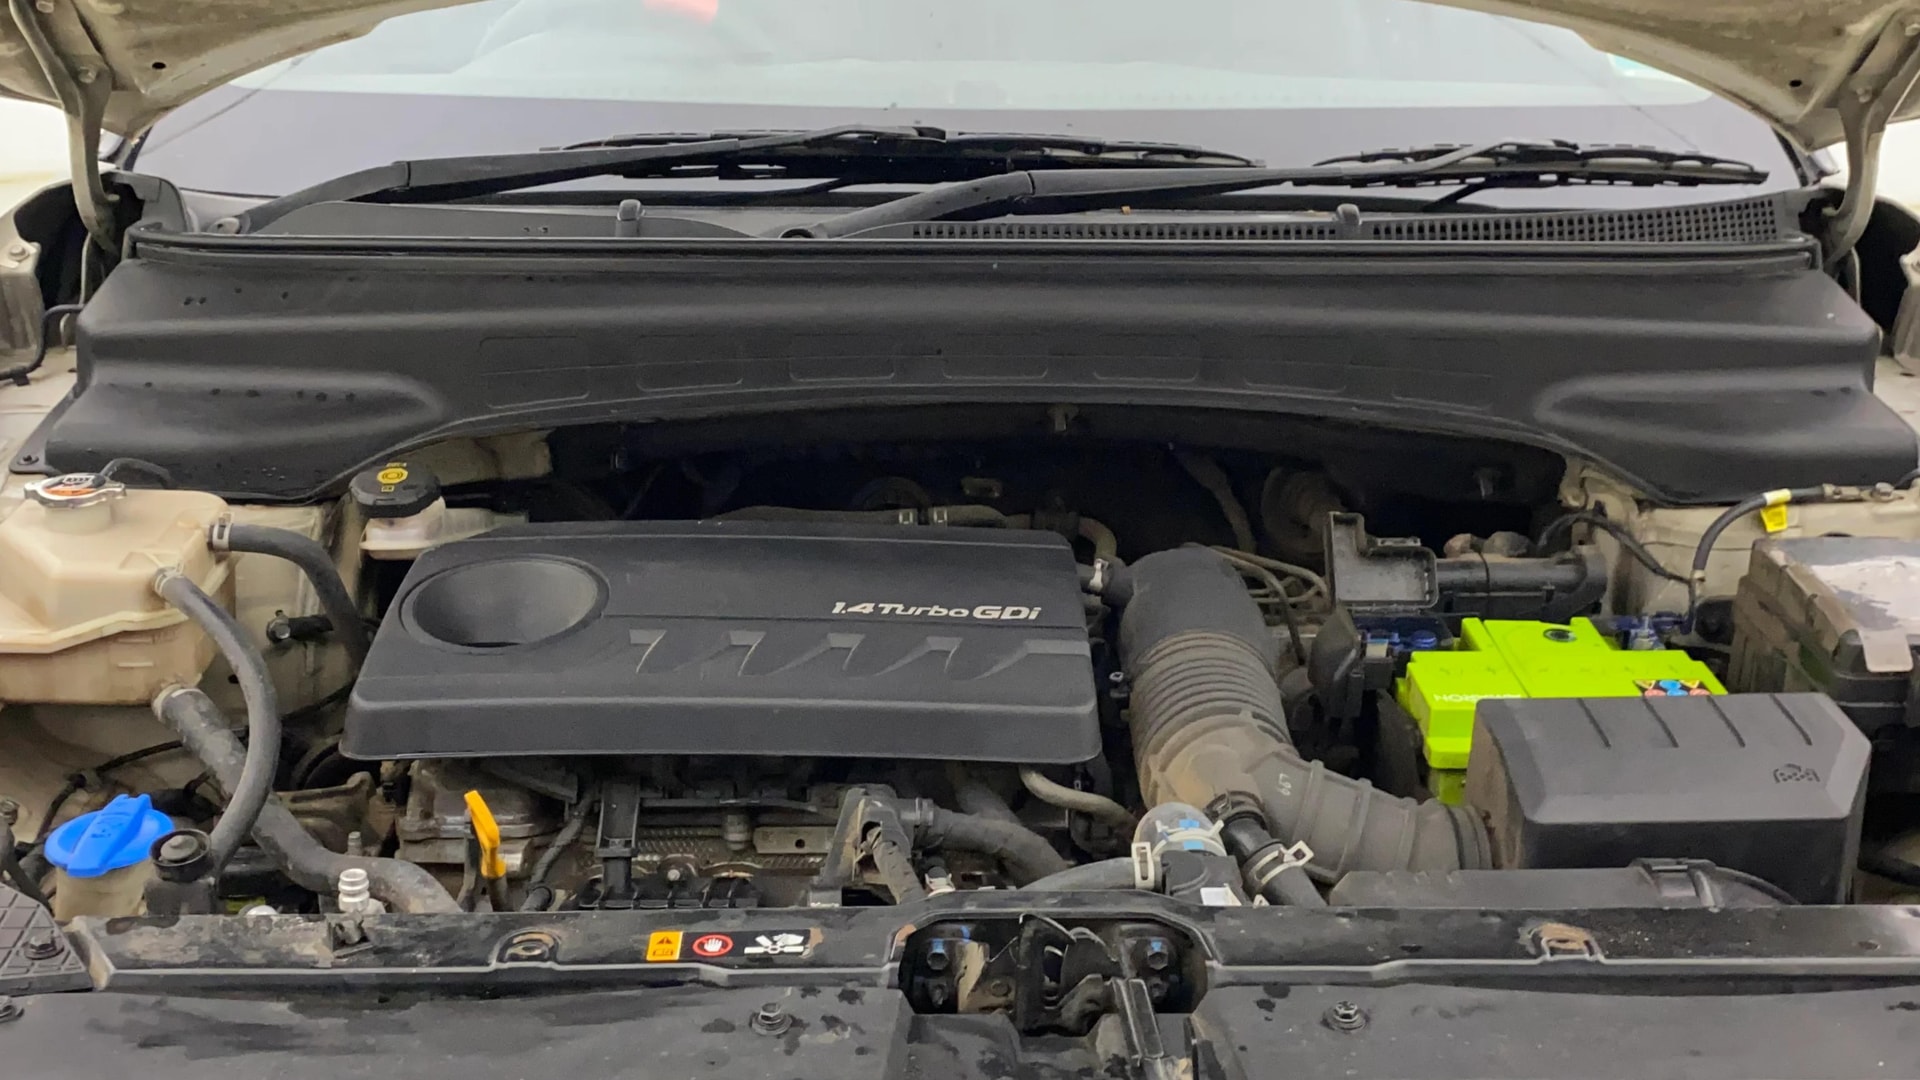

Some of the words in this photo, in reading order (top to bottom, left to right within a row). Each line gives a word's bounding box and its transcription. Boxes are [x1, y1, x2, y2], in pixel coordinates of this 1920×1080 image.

[832, 601, 875, 615] 1.4
[877, 603, 970, 618] Turbo
[971, 605, 1042, 620] GDi
